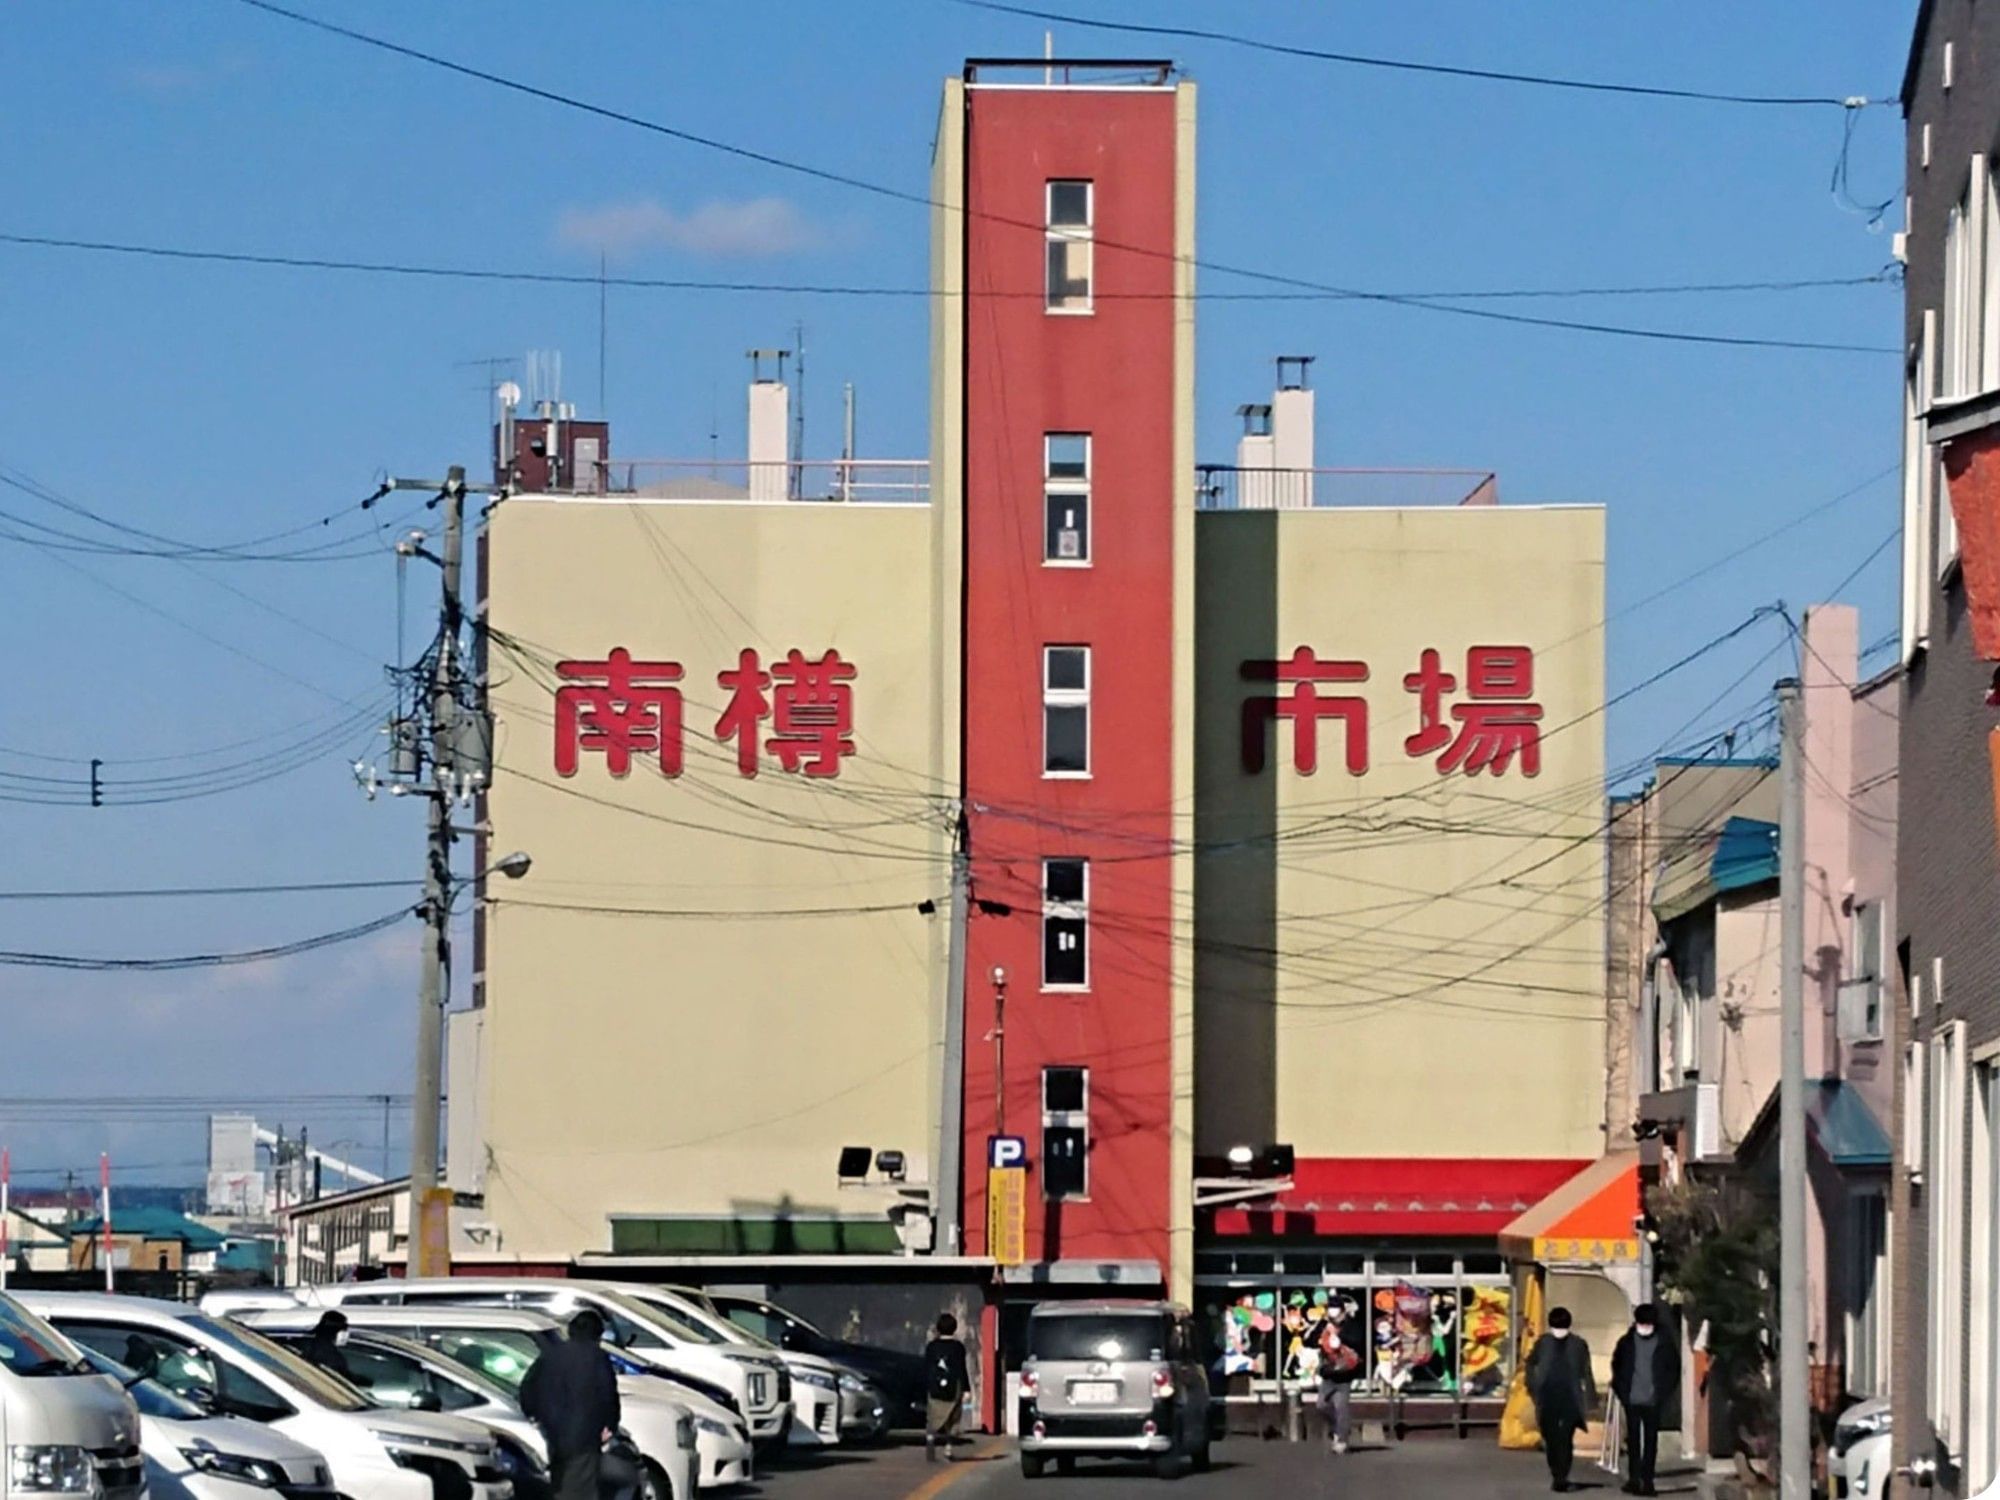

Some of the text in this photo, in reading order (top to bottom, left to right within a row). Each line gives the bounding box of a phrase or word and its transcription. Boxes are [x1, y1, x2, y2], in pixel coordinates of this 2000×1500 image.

[554, 645, 1544, 779] 南樽 市場
[994, 1139, 1022, 1167] P
